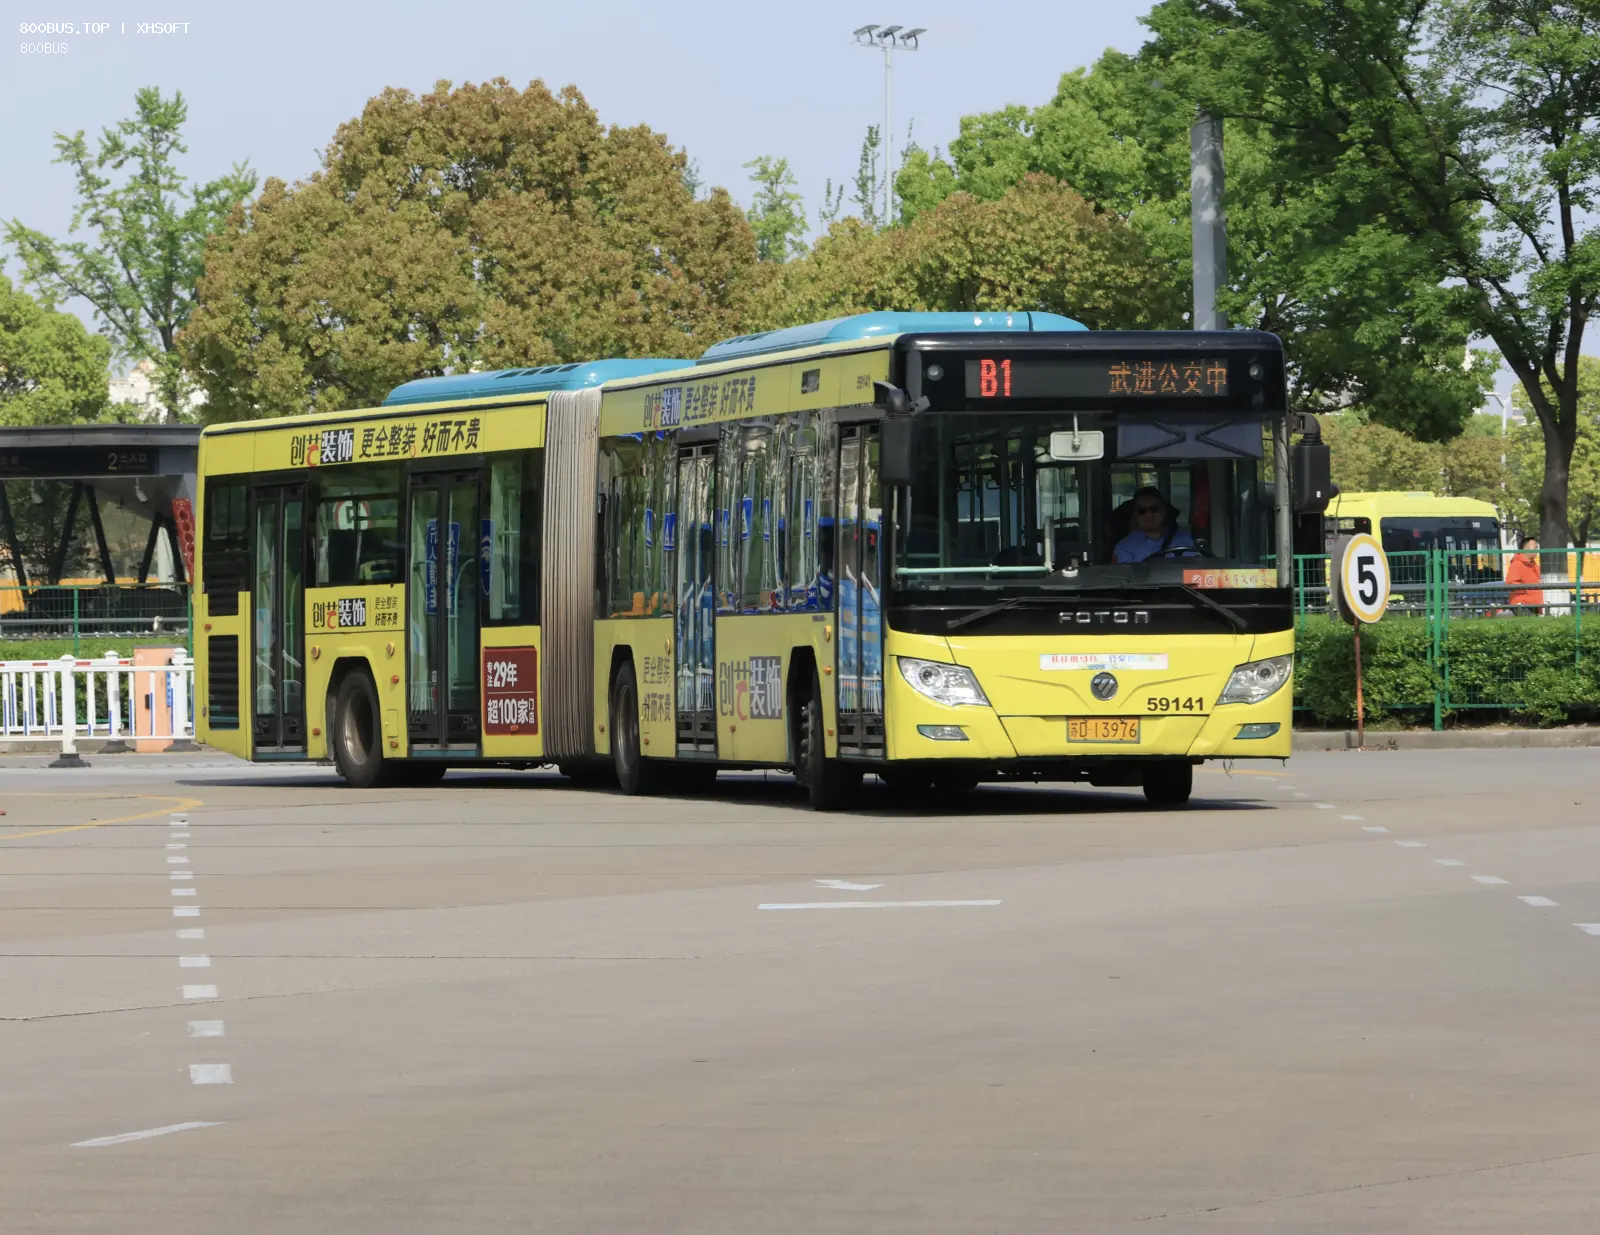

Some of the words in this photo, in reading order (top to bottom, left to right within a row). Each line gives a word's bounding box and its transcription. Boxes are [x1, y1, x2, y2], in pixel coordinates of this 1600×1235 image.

[980, 358, 1011, 397] B1
[1108, 361, 1227, 395] 武进公交中
[291, 428, 354, 467] 创艺装饰
[359, 423, 417, 458] 更全整装
[421, 417, 480, 454] 好而不贵
[1357, 555, 1379, 606] 5
[312, 597, 366, 629] 创艺装饰
[1058, 611, 1149, 624] FOTON
[719, 655, 783, 721] 创艺装饰
[1146, 696, 1204, 712] 59141
